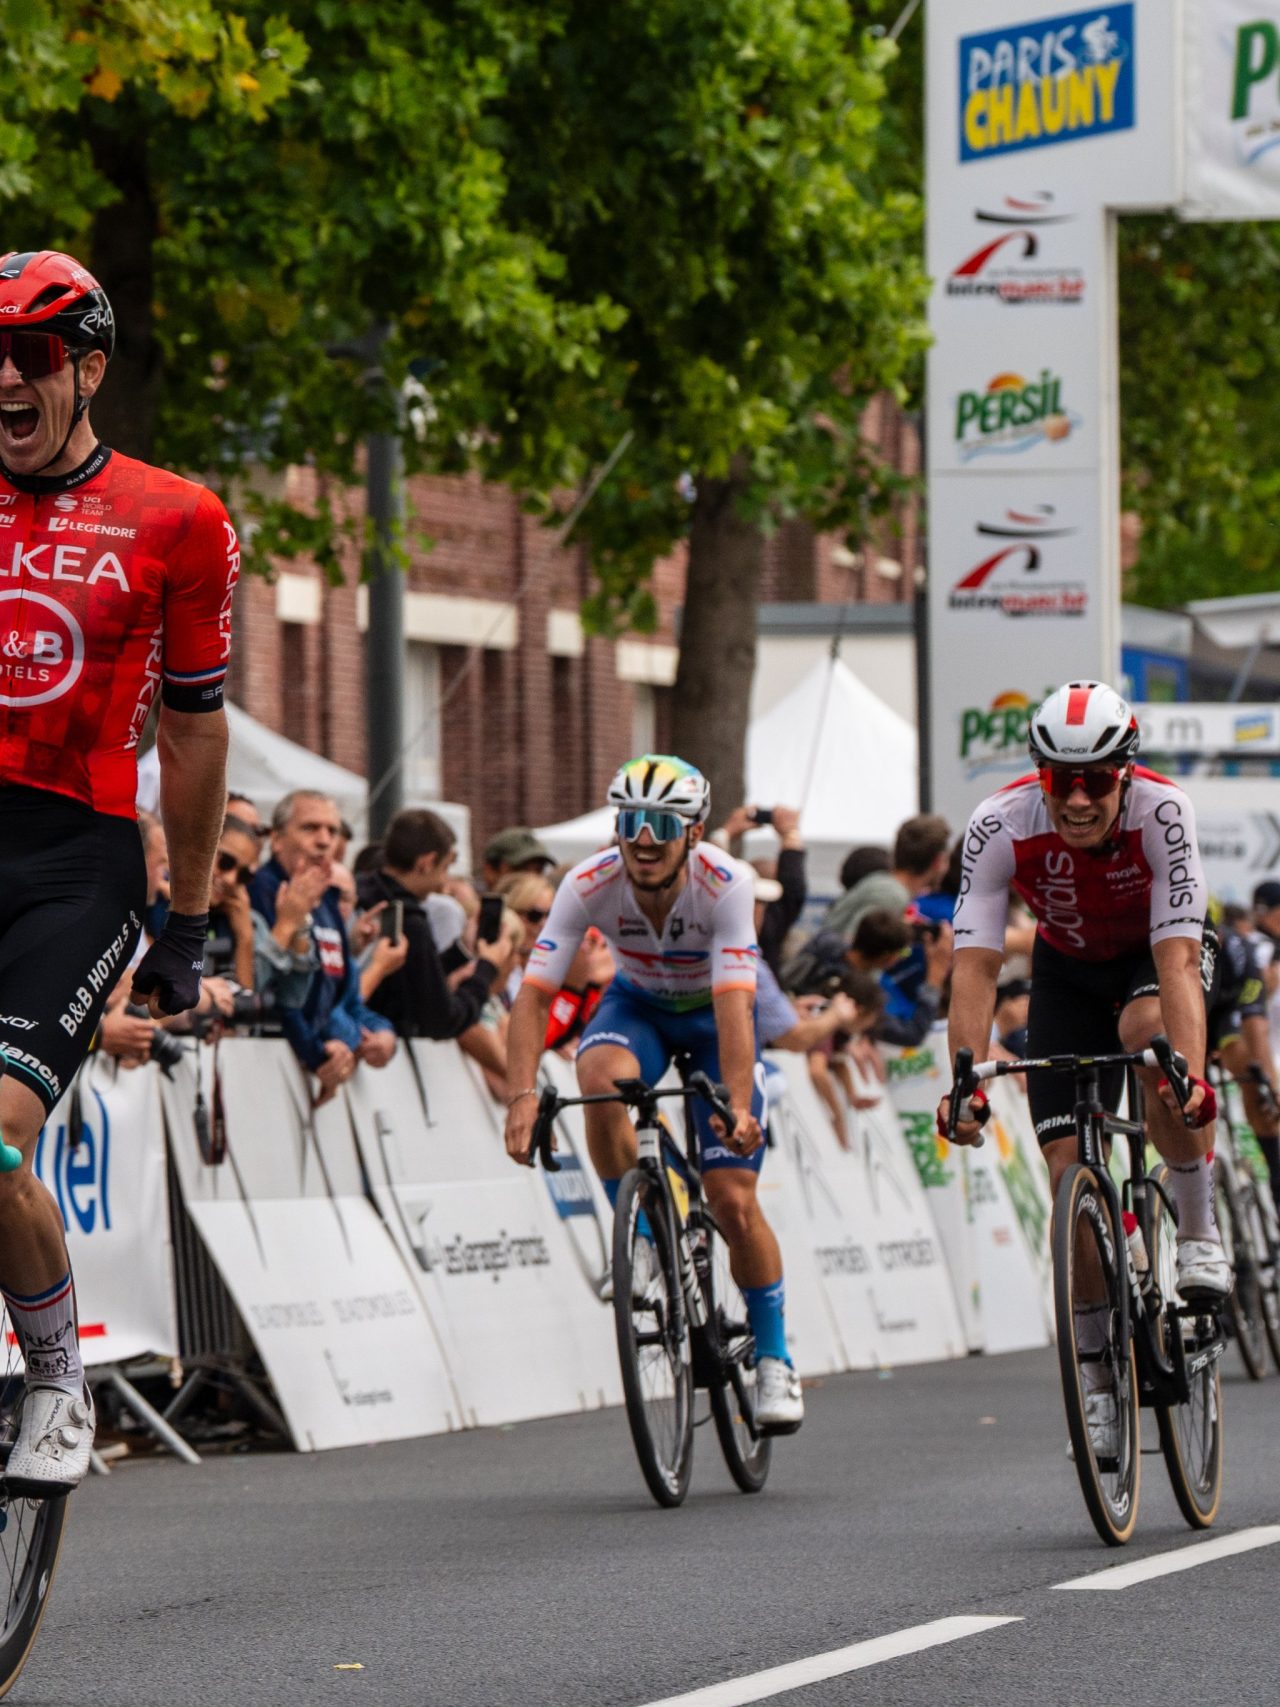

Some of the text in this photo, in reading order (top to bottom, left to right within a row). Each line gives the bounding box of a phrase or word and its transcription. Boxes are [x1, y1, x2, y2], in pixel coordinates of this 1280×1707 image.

[968, 25, 1077, 92] PARIS
[964, 59, 1121, 151] CHAUNY
[85, 454, 104, 475] HOTELS
[69, 522, 137, 539] LEGENDRE
[81, 503, 112, 512] WORLD
[81, 509, 104, 517] TEAM
[83, 496, 101, 504] UCI
[219, 520, 241, 660] ARKEA
[1155, 800, 1198, 909] Cofidis
[59, 922, 129, 1038] B&B HOTELS
[33, 1088, 112, 1234] uel
